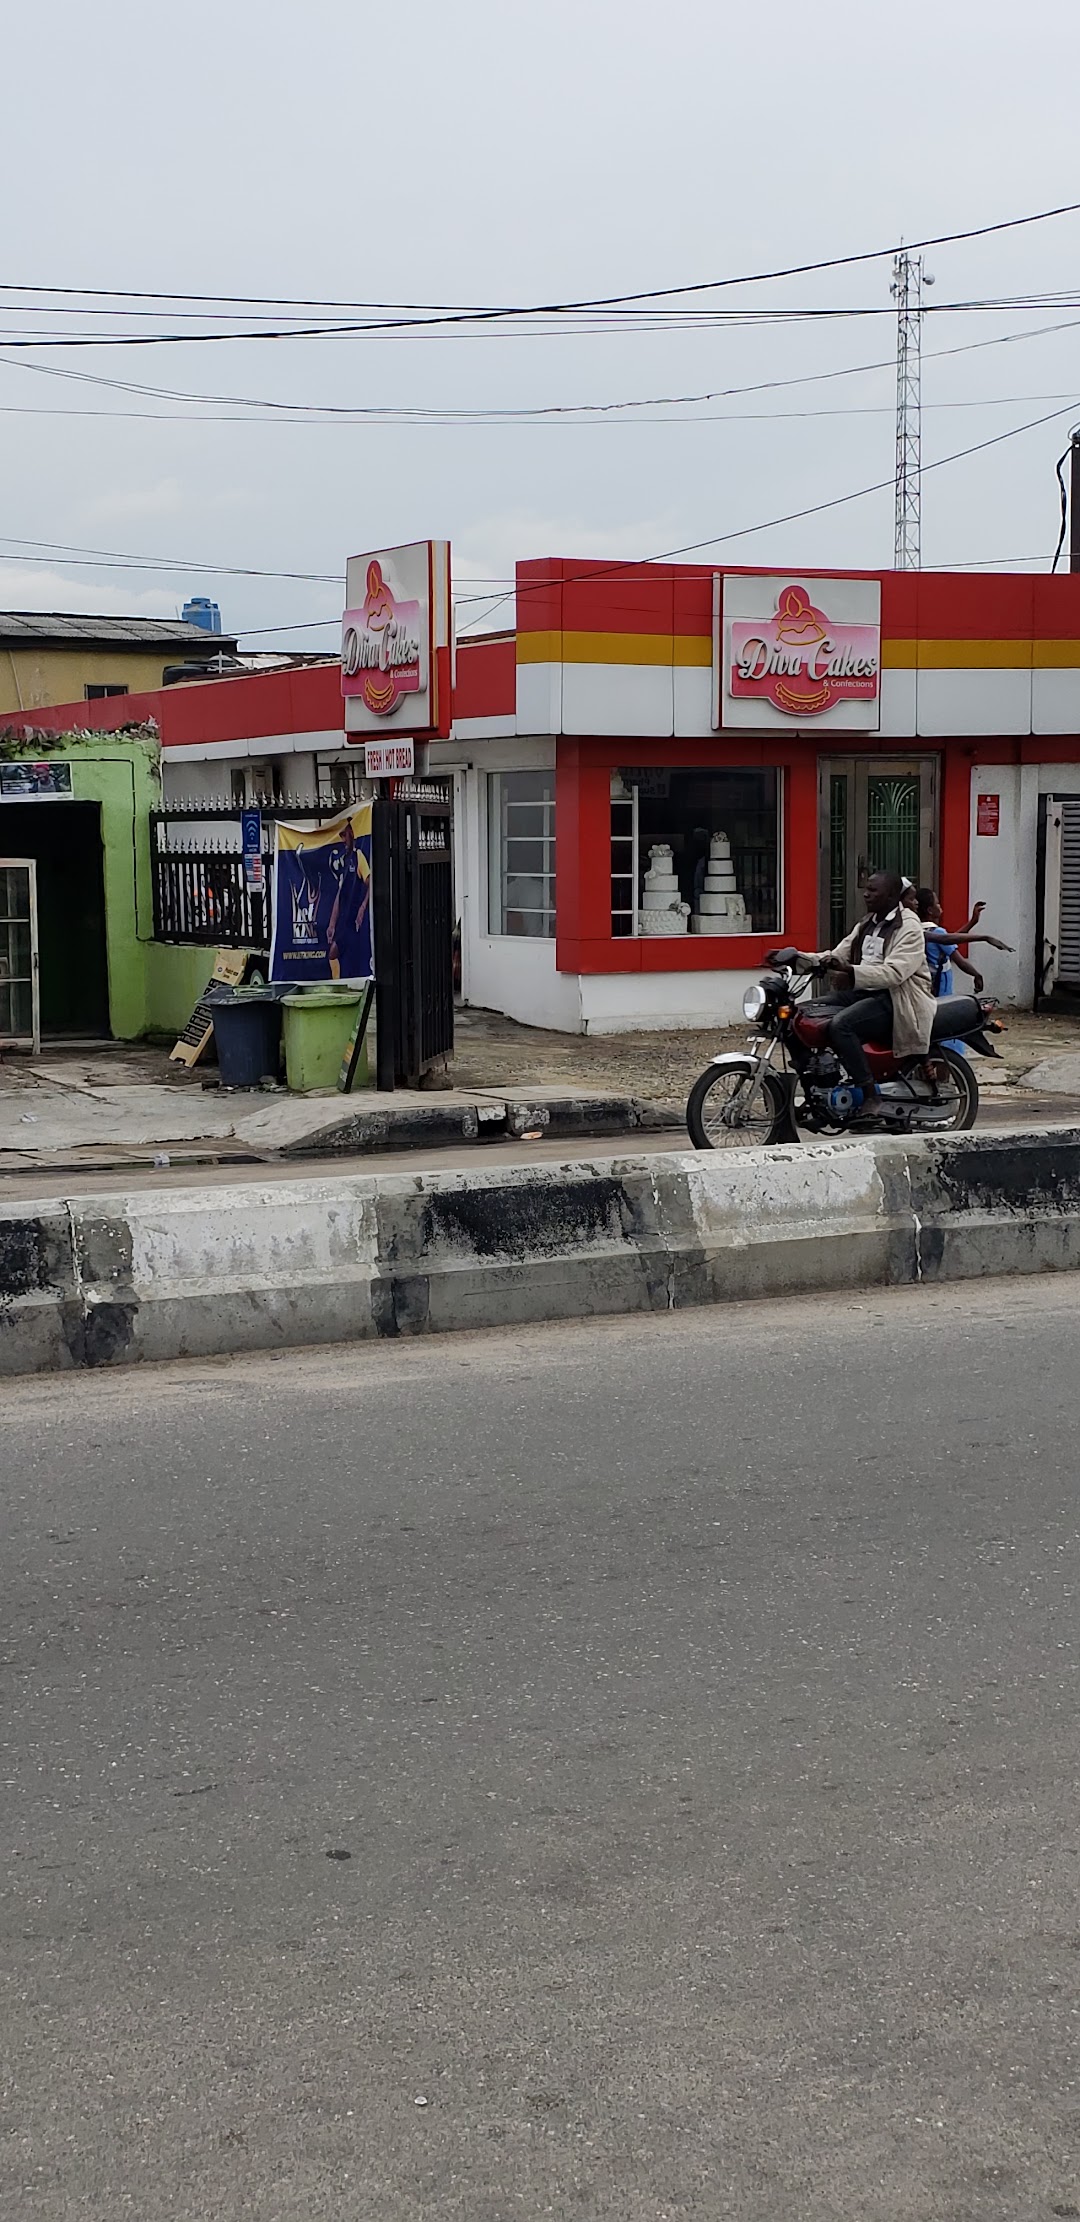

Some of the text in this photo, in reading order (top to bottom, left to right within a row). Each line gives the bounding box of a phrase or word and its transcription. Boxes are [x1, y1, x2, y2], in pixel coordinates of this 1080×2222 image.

[341, 621, 419, 675] Diva Cakes
[736, 637, 878, 680] Diva Cakes
[831, 680, 874, 688] Confections
[368, 749, 383, 771] FRESH
[385, 748, 395, 770] HOT
[396, 746, 412, 769] BREAD
